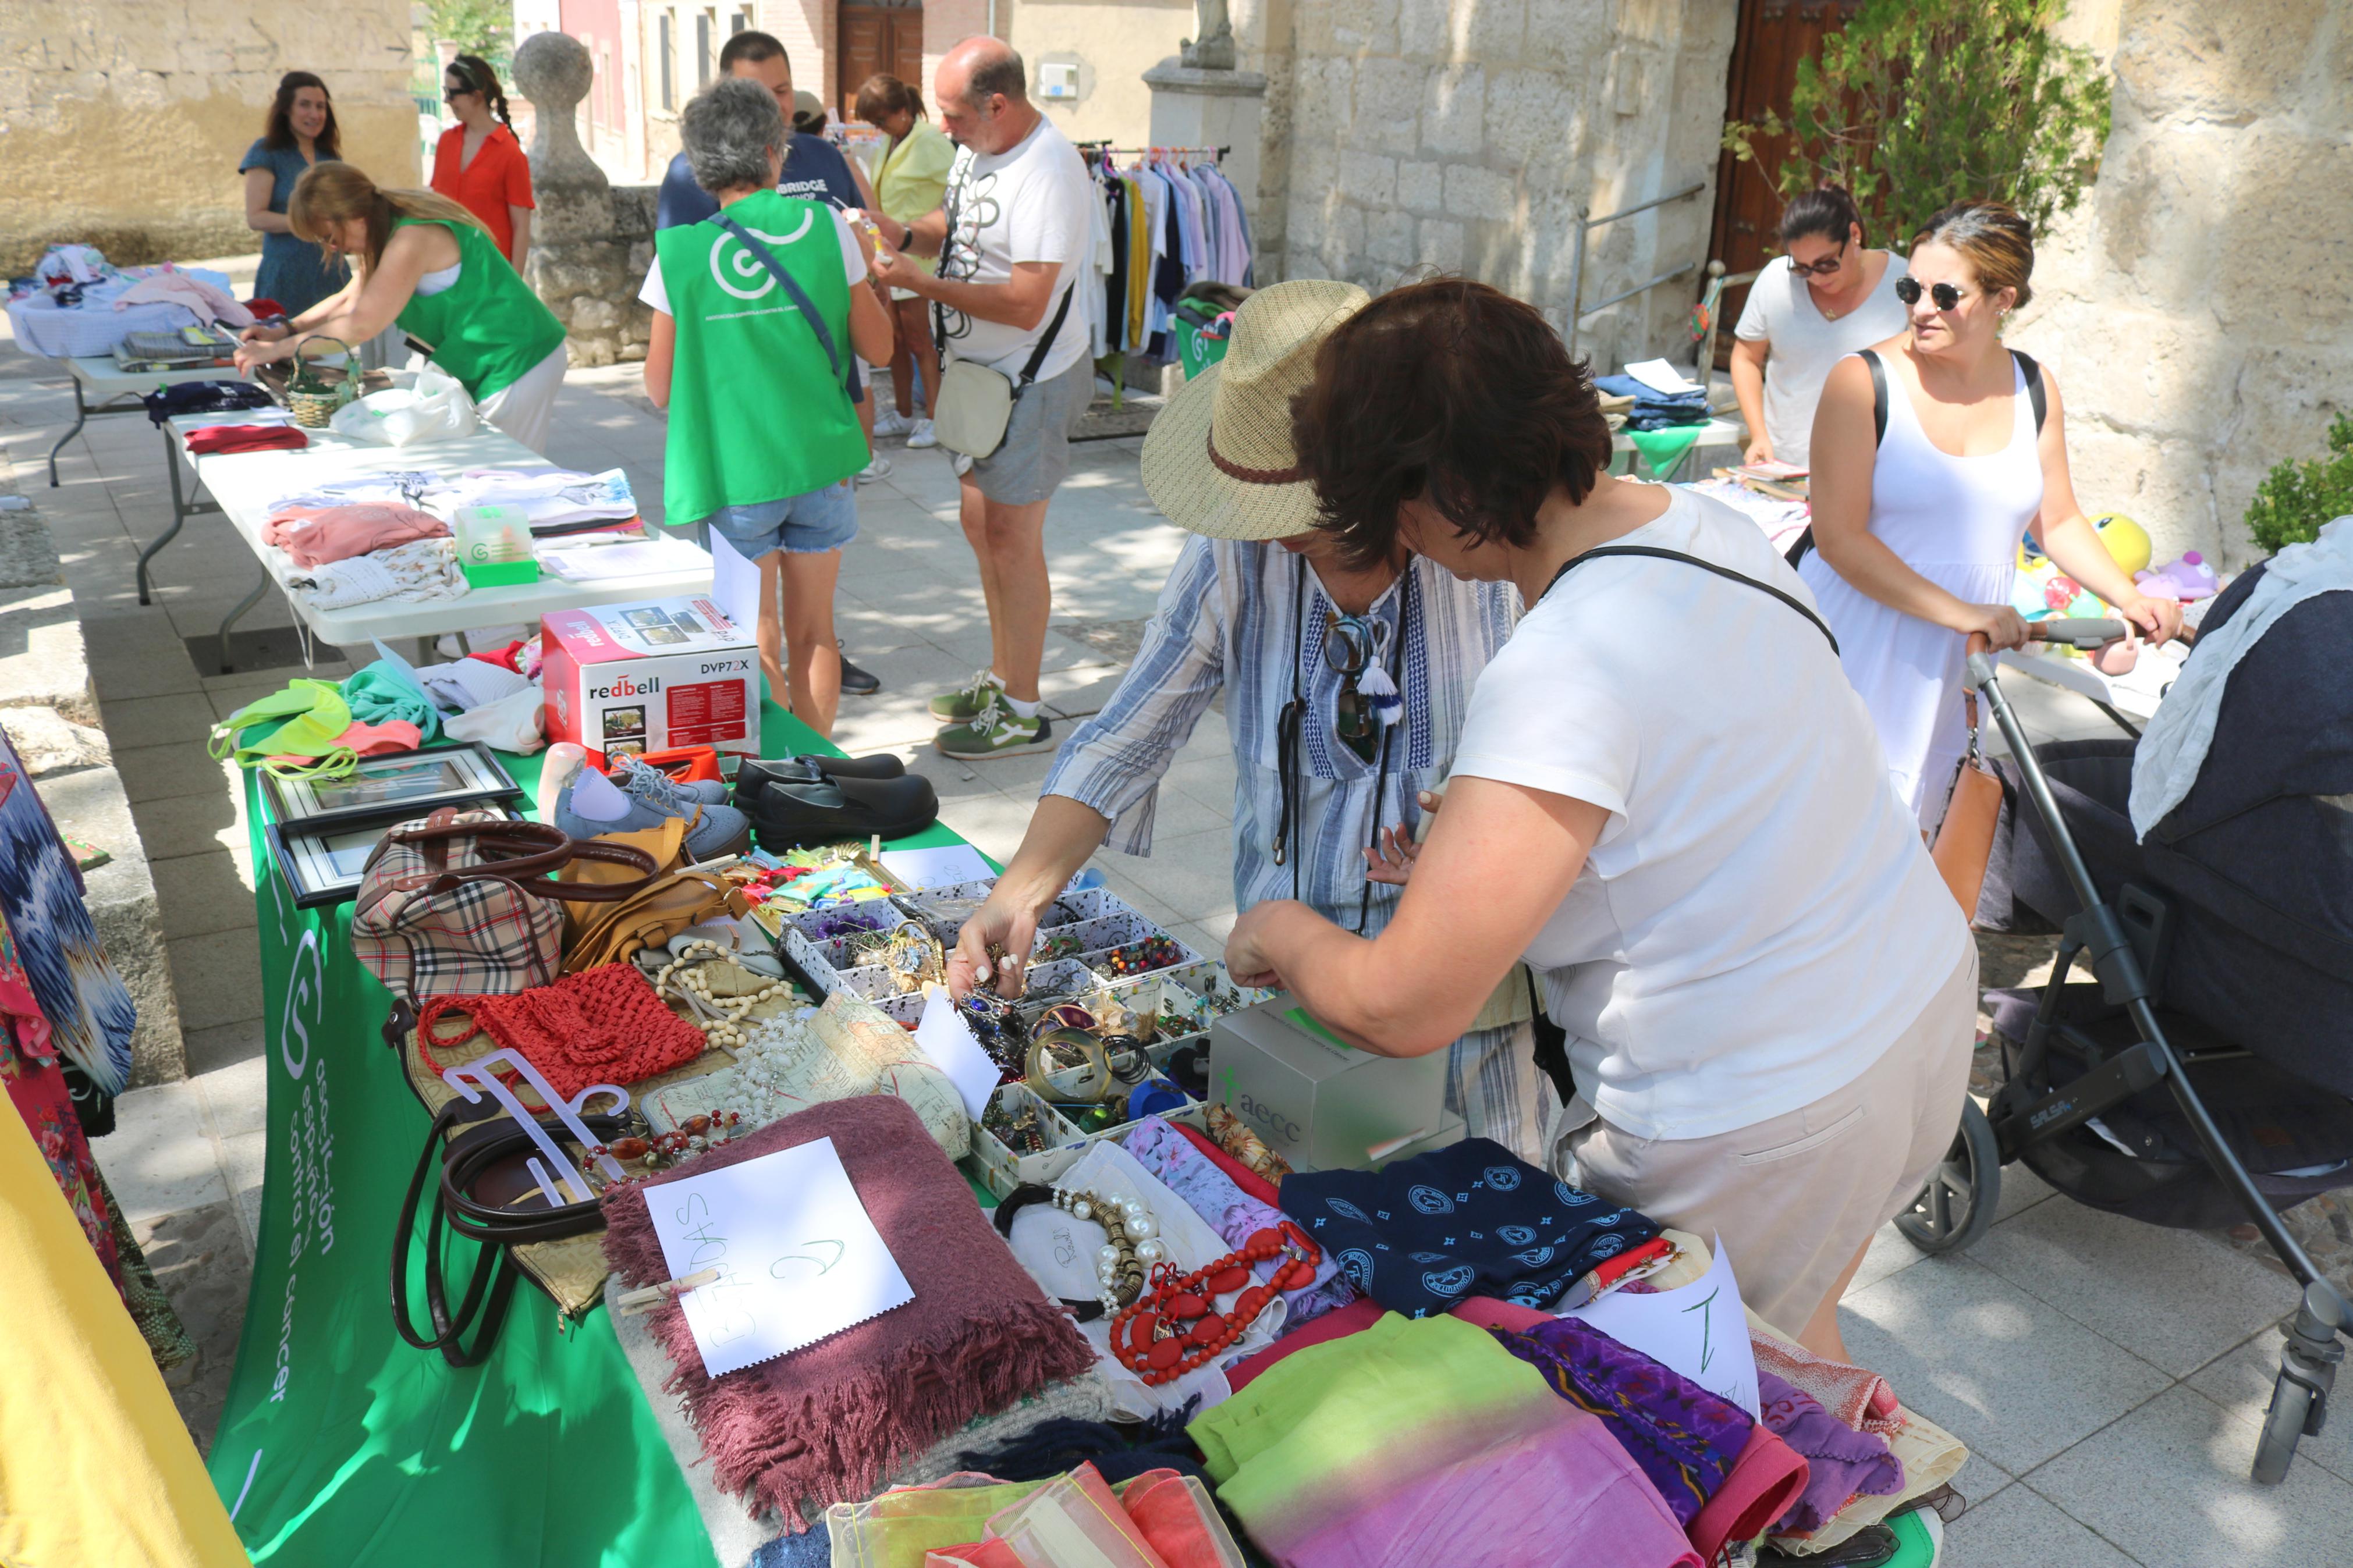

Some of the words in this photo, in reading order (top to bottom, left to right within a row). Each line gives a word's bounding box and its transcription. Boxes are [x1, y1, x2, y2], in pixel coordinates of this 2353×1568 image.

[590, 674, 660, 699] redbell
[701, 659, 749, 674] DVP72X
[1240, 1094, 1301, 1142] aecc
[290, 1110, 304, 1229] contra
[289, 1232, 303, 1269] el
[270, 1273, 297, 1403] cáncer
